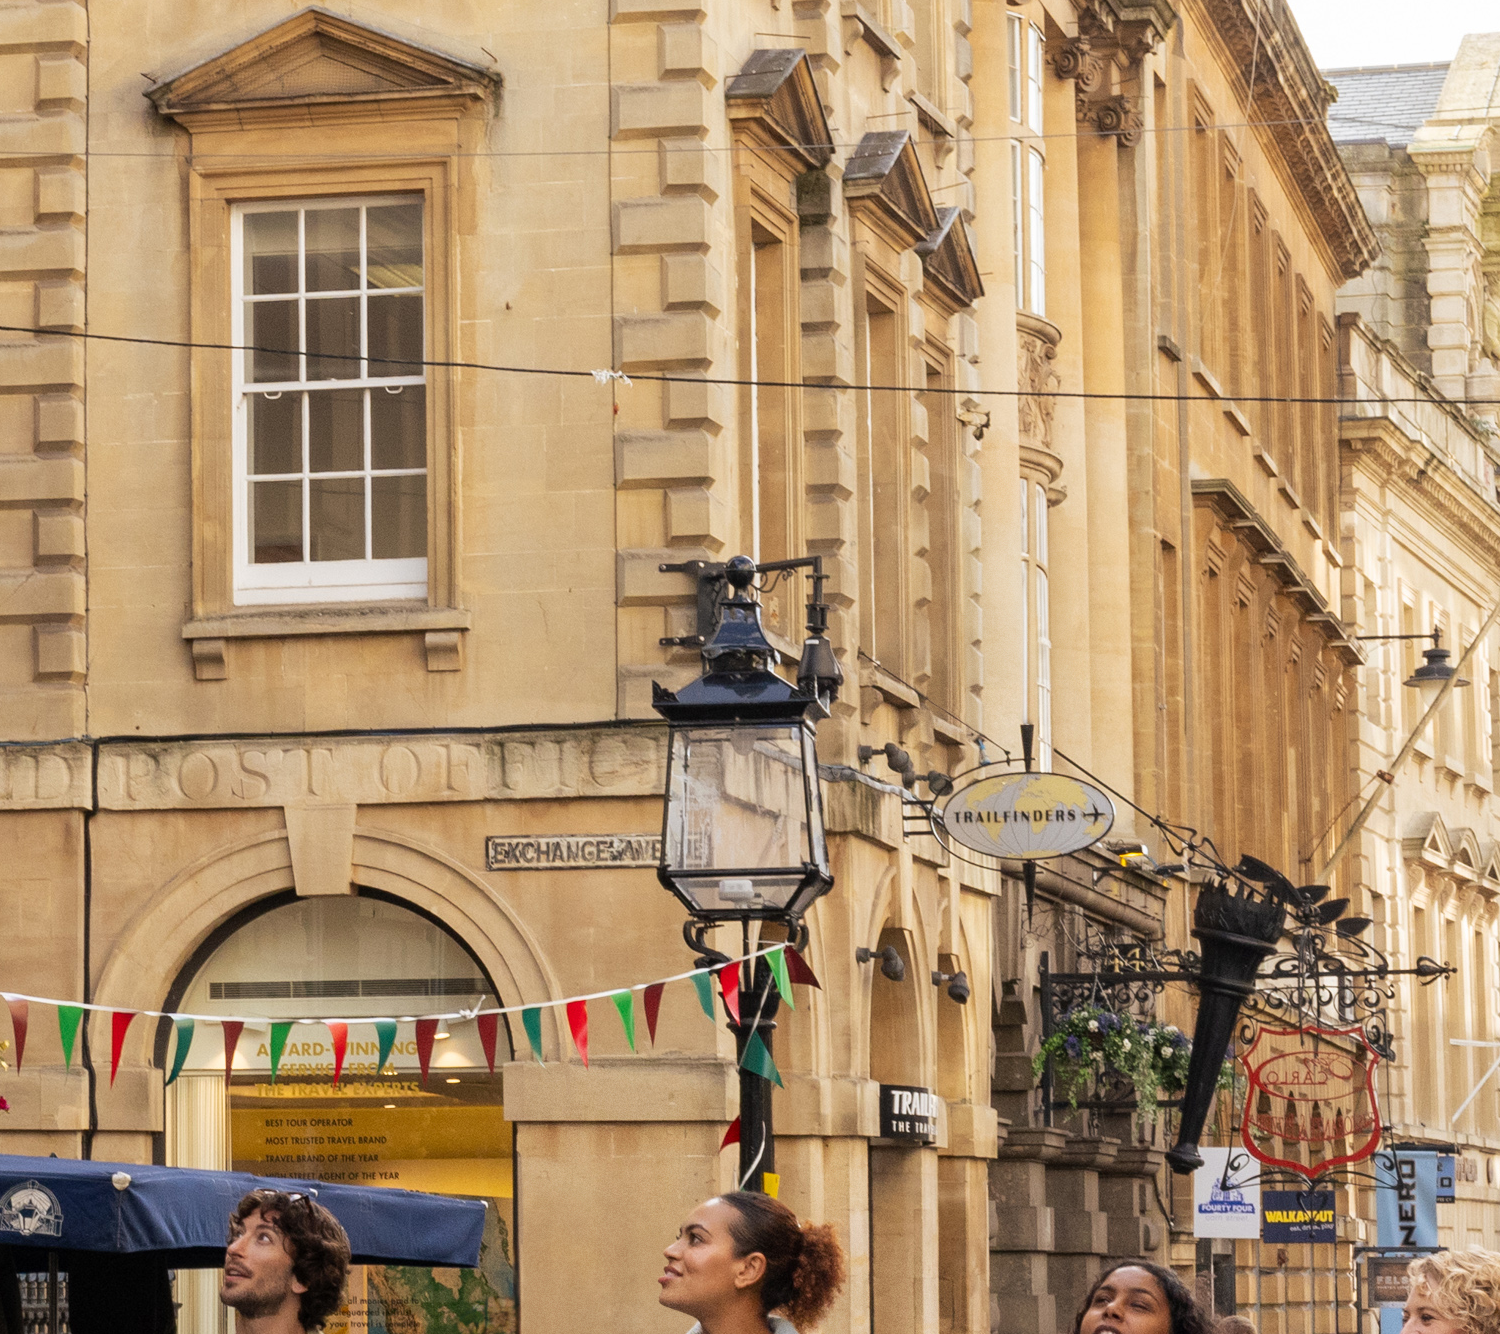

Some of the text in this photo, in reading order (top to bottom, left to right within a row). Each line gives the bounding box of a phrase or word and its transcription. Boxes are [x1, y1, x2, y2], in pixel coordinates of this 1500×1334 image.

[117, 749, 333, 802] POST
[954, 809, 1076, 824] TRAILFINDERS
[493, 839, 609, 864] EXCHANGE
[256, 1082, 420, 1097] THE TRAVEL EXPERTS
[265, 1118, 354, 1128] BEST TOUR OPERATOR
[892, 1120, 911, 1133] THE
[265, 1135, 387, 1145] MOST TRUSTED TRAVEL BRAND
[265, 1154, 380, 1163] TRAVEL BRAND OF THE YEAR
[319, 1172, 343, 1181] AGENT
[348, 1171, 359, 1181] OF
[360, 1171, 377, 1181] THE
[379, 1171, 400, 1181] YEAR
[1201, 1203, 1253, 1212] FOURTY FOUR
[1399, 1158, 1417, 1246] NERO
[1264, 1210, 1335, 1223] WALKAOUT
